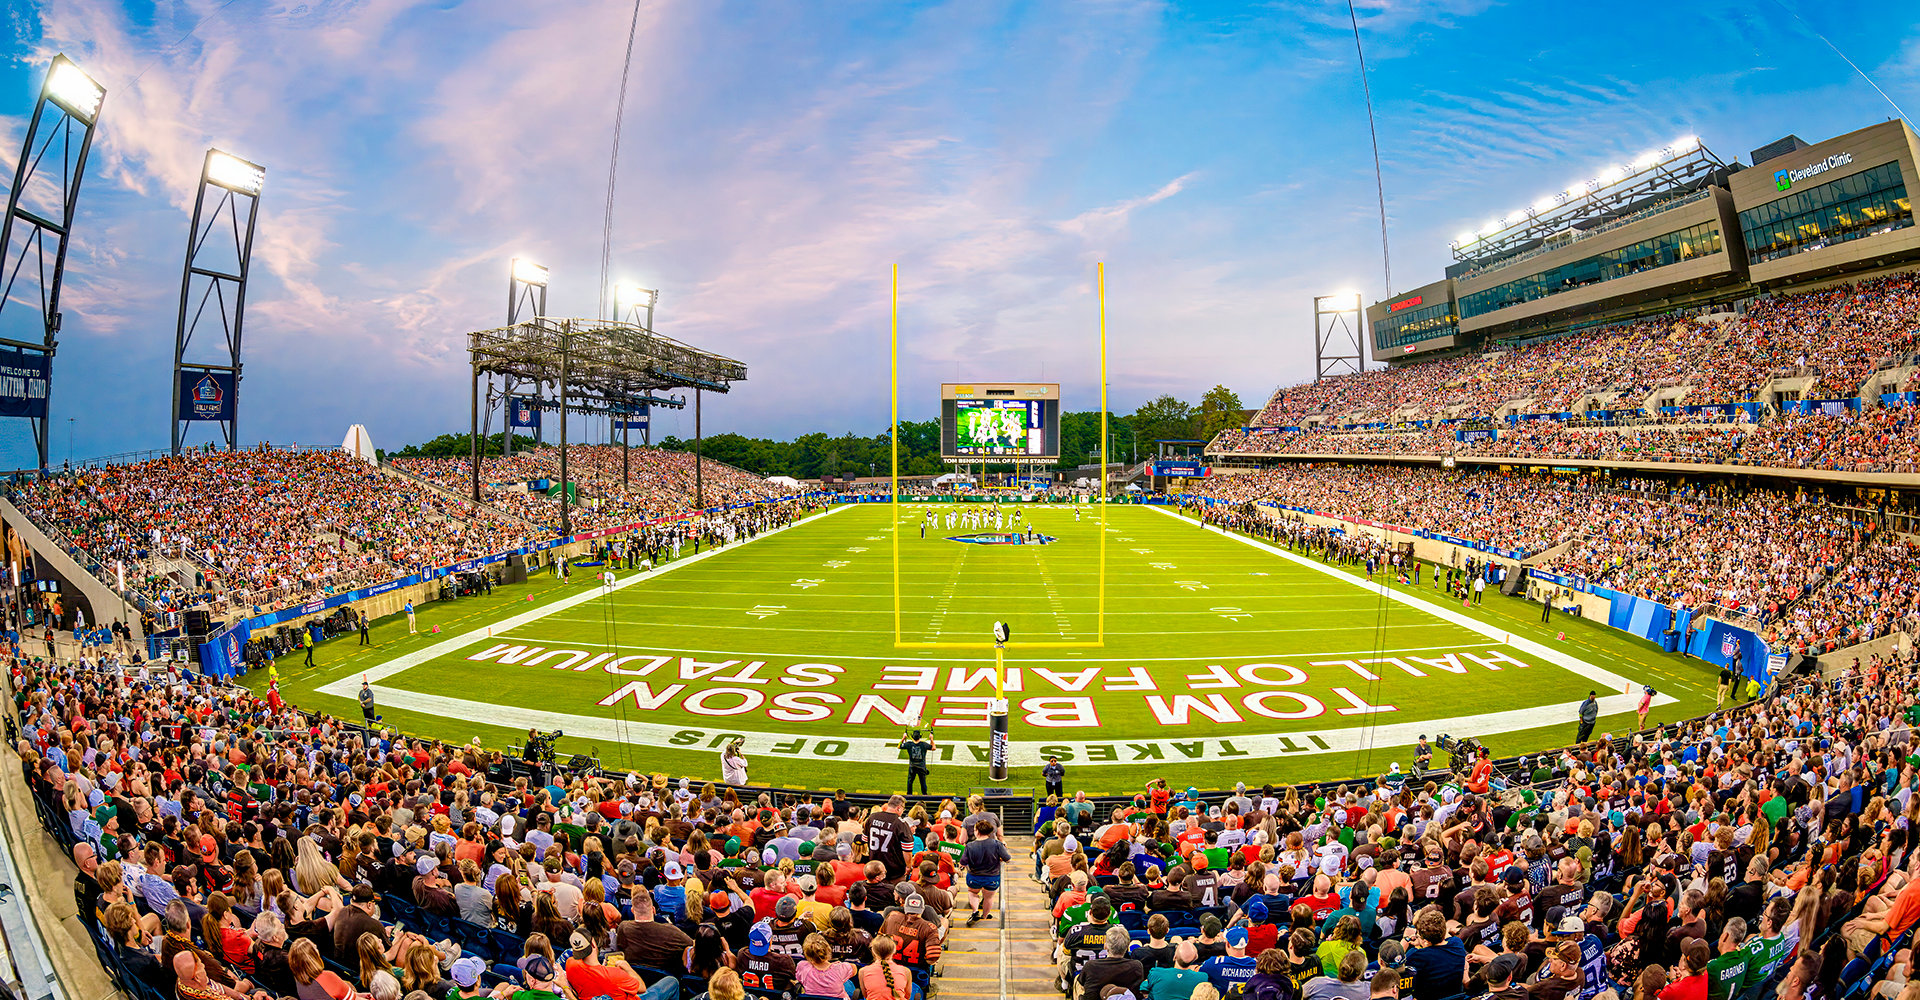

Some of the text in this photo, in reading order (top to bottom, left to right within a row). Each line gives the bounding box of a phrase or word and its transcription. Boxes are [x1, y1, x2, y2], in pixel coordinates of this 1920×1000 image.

[1789, 151, 1853, 183] Cleveland Clinic
[0, 366, 41, 377] WELCOME TO
[28, 378, 46, 399] OHIO
[464, 643, 1531, 692] HALL OF FAME STADIUM
[595, 680, 1400, 728] TOM BENSON
[668, 729, 746, 749] US
[770, 738, 850, 757] OF
[993, 729, 1002, 768] FOOTBALL
[1277, 734, 1331, 753] IT
[1039, 739, 1250, 762] TAKES
[869, 826, 893, 853] 67
[1723, 862, 1737, 884] 23
[1201, 886, 1215, 907] 4
[1560, 888, 1584, 904] GARRETT
[1583, 943, 1599, 961] WARE
[748, 959, 770, 972] WARD
[1720, 961, 1746, 981] GARDNER
[1727, 982, 1736, 1000] 1
